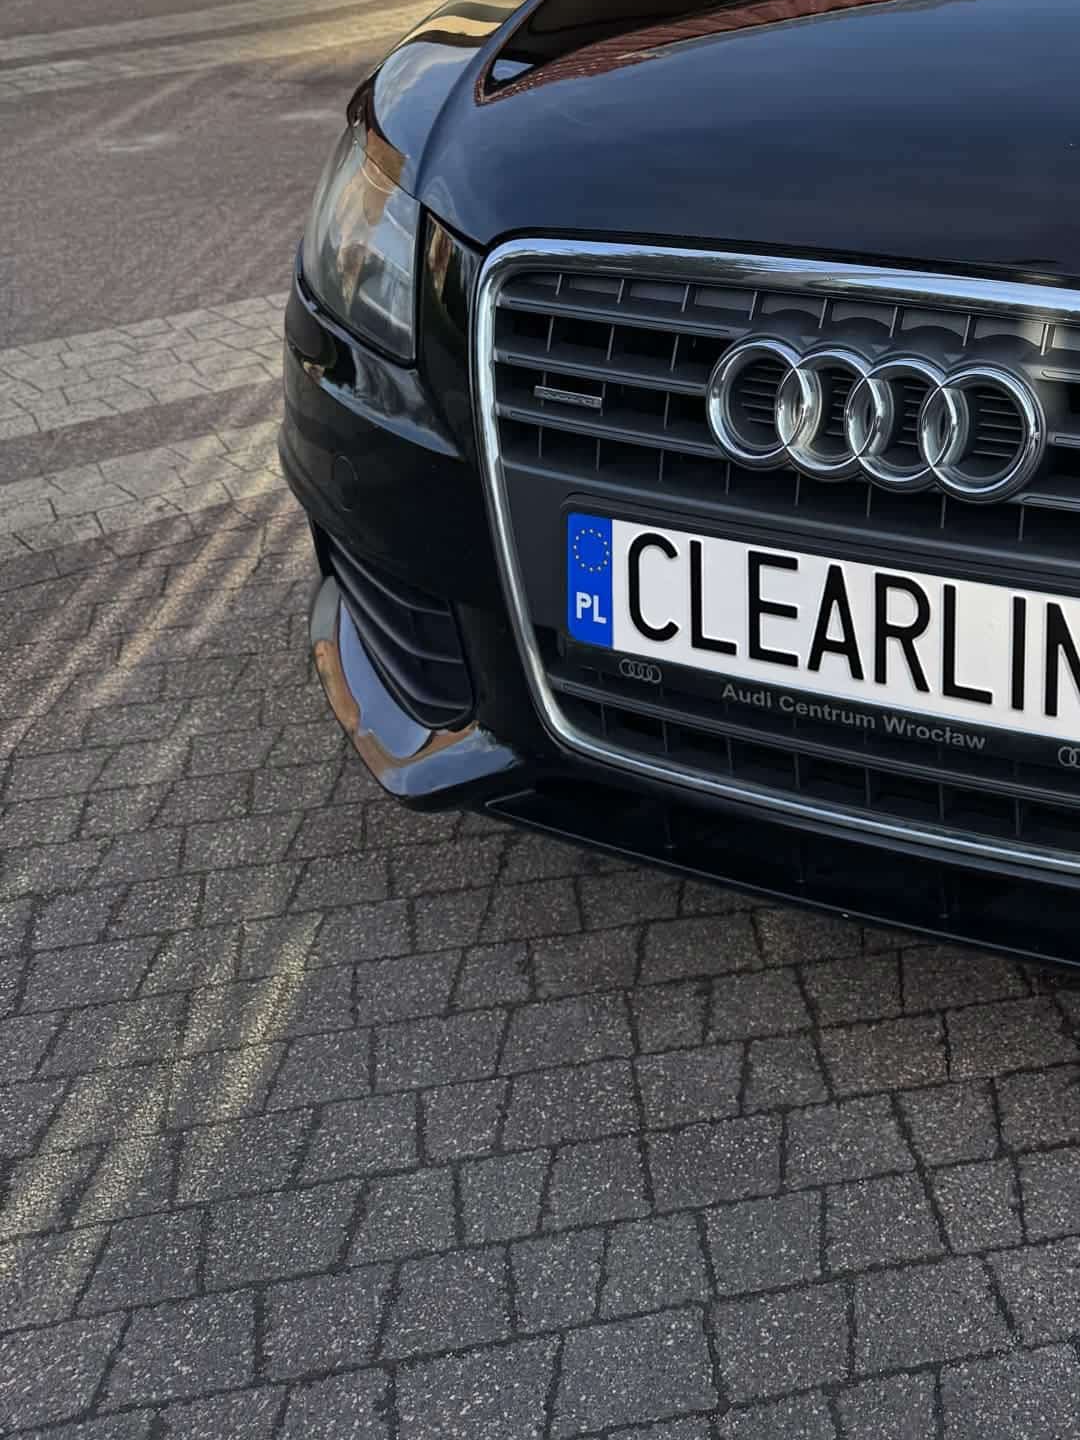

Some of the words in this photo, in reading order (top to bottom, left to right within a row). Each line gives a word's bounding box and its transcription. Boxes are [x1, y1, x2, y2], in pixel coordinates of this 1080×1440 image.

[576, 591, 607, 624] PL
[721, 683, 772, 709] Audi
[779, 695, 876, 729] Centrum
[882, 715, 986, 750] Wrocław
